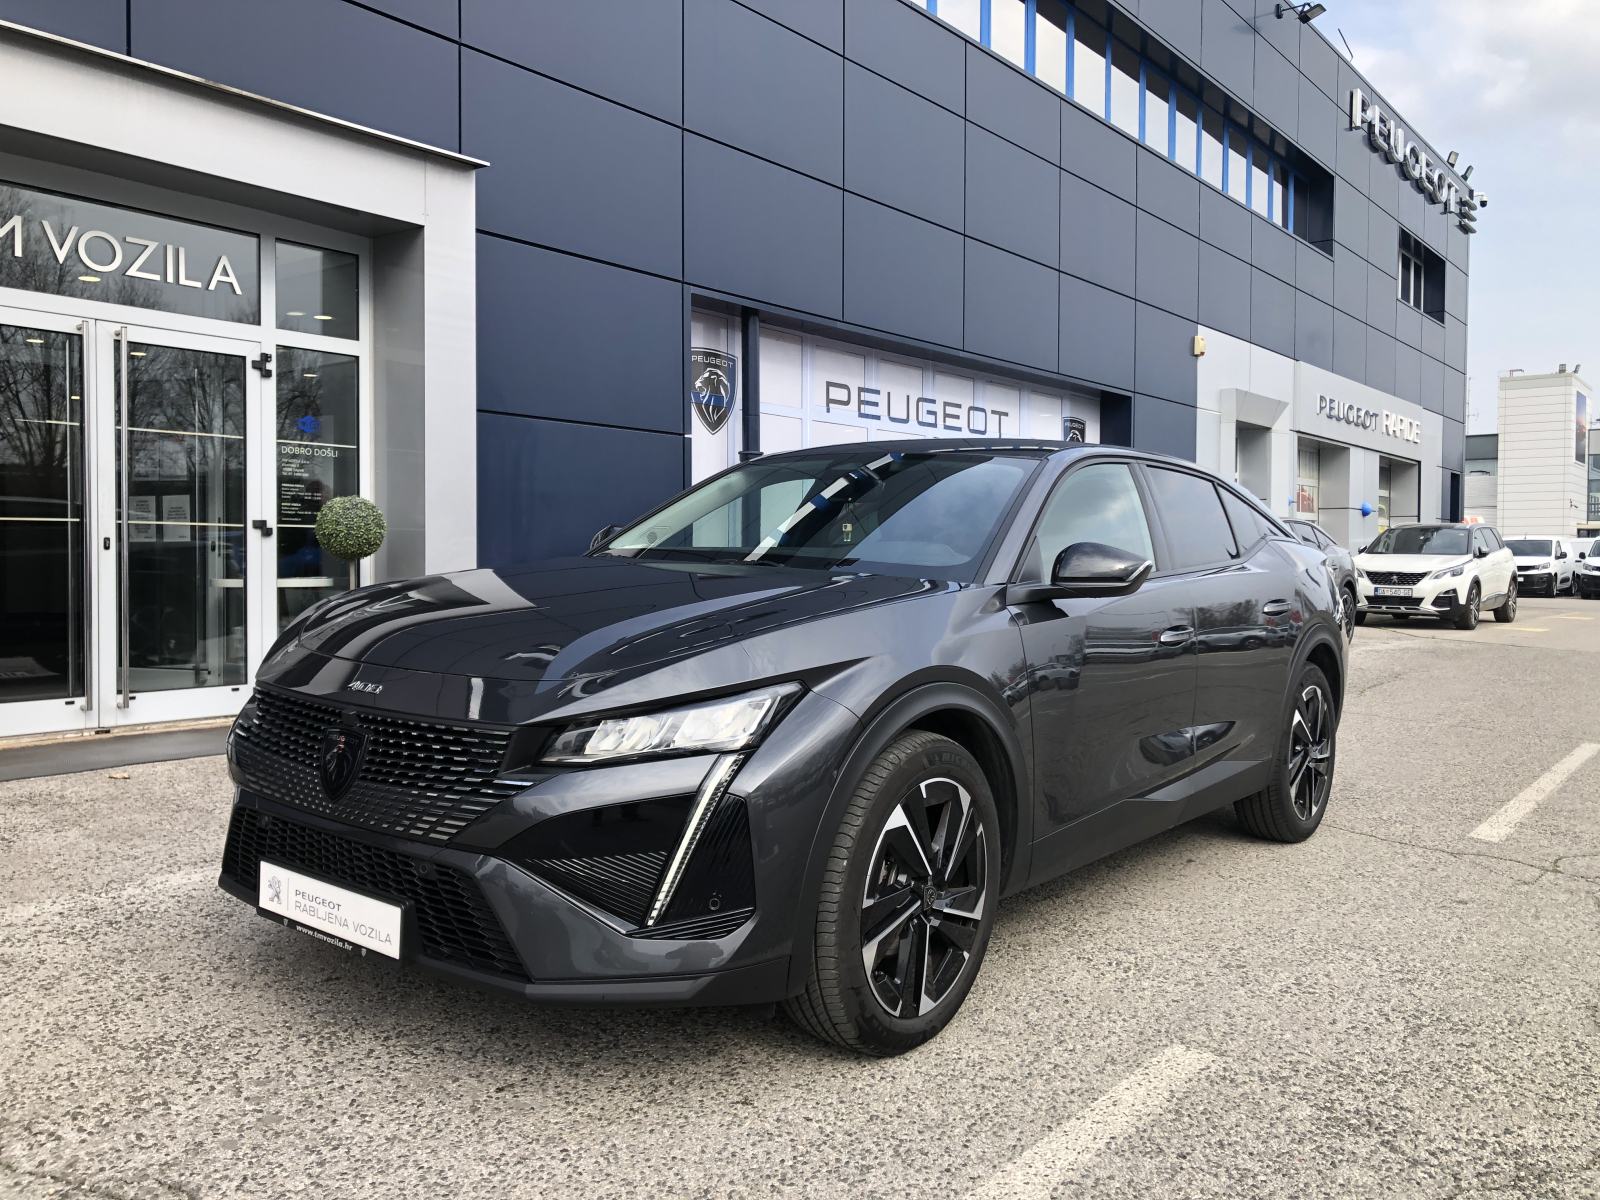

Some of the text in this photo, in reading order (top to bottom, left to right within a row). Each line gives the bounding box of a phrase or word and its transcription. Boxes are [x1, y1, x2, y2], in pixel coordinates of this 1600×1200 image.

[1351, 88, 1460, 214] PEUGEOT
[41, 219, 243, 296] VOZILA
[691, 354, 734, 369] PEUGEOT
[825, 380, 1009, 439] PEUGEOT
[1317, 394, 1422, 444] PEUGEOT RAPIDE
[281, 445, 338, 458] DOBRO DOŠLI
[294, 889, 342, 912] PEUGEOT
[294, 900, 393, 946] RABLJENA VOZILA
[295, 925, 353, 951] www.tmvozila.hr
